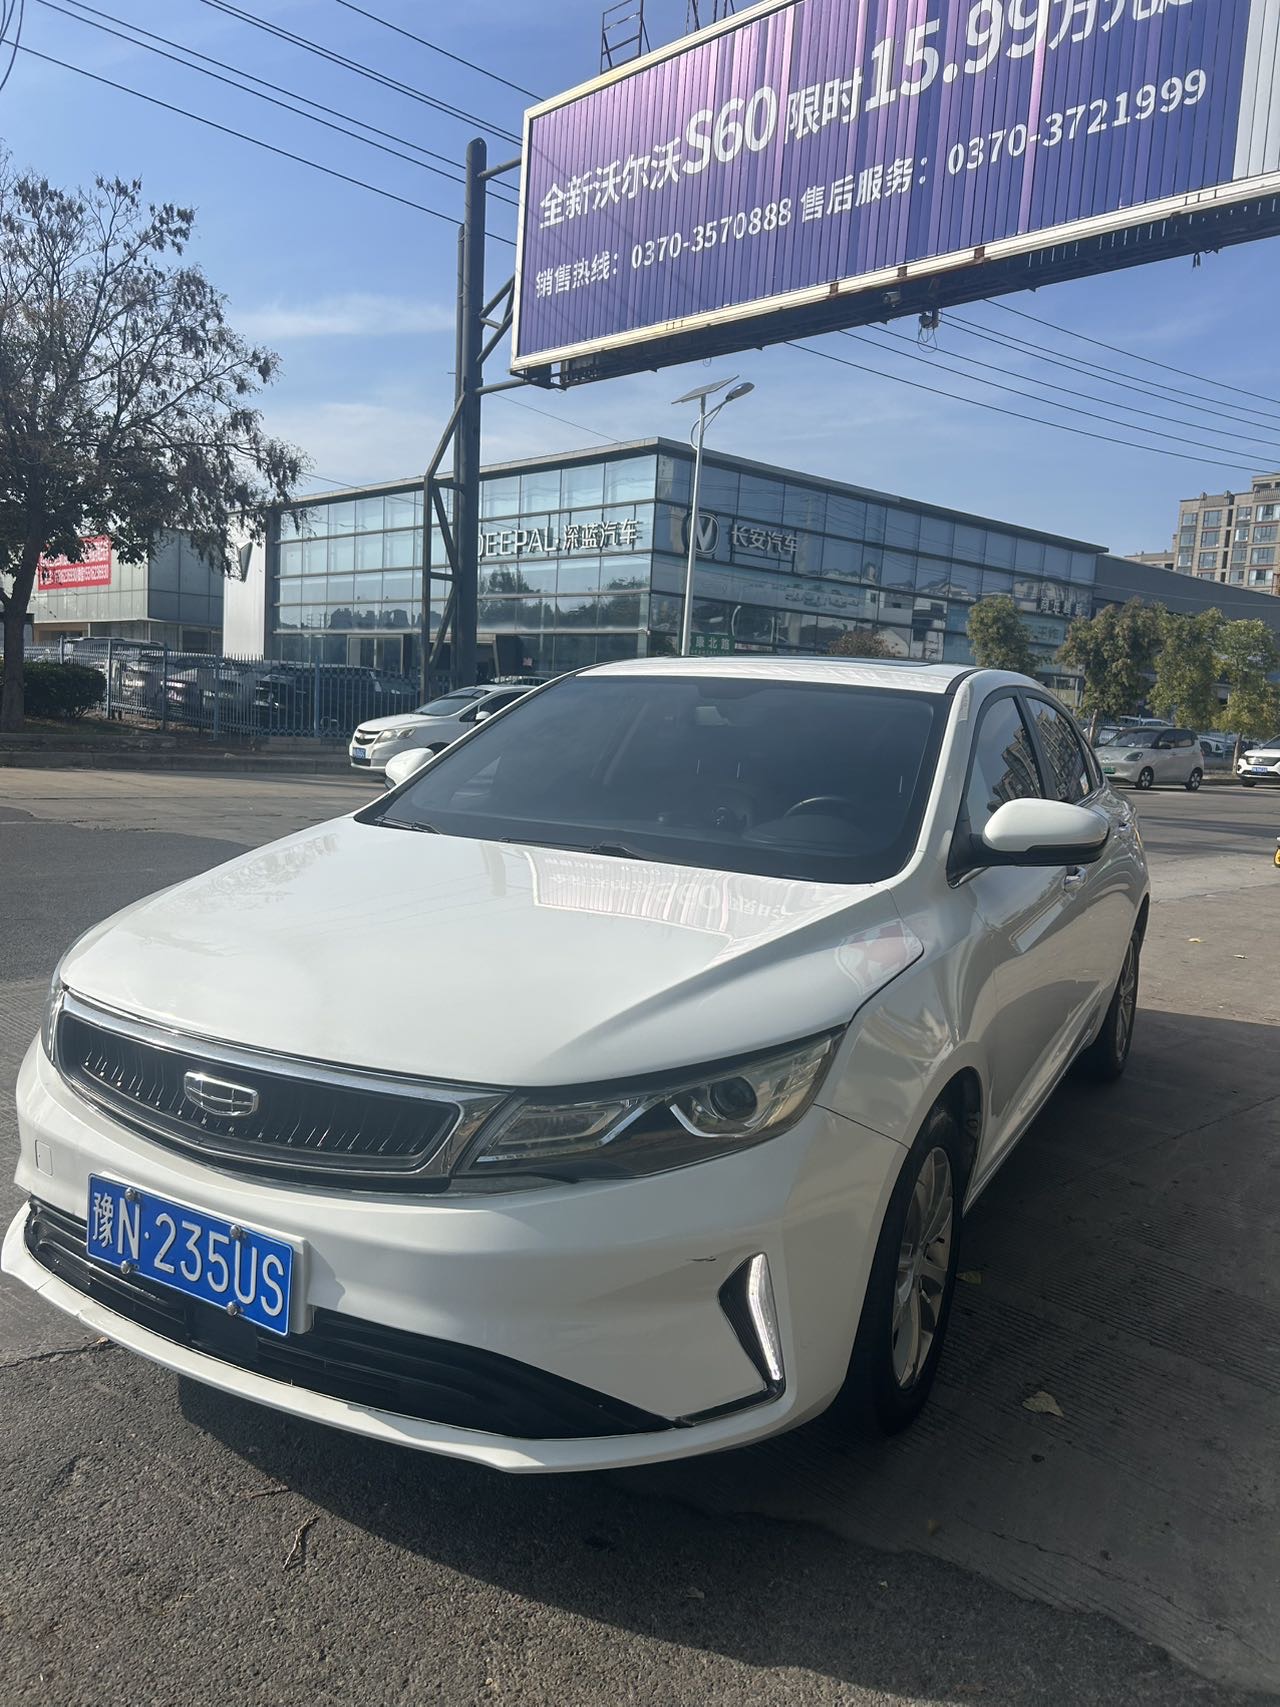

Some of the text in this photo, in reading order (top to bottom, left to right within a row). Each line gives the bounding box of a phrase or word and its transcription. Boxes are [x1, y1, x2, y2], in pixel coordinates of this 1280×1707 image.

[631, 198, 792, 269] 0370-3570888
[948, 68, 1207, 175] 0370-3721999
[731, 524, 799, 554] 长安汽车
[93, 1192, 284, 1317] 豫N·235US
